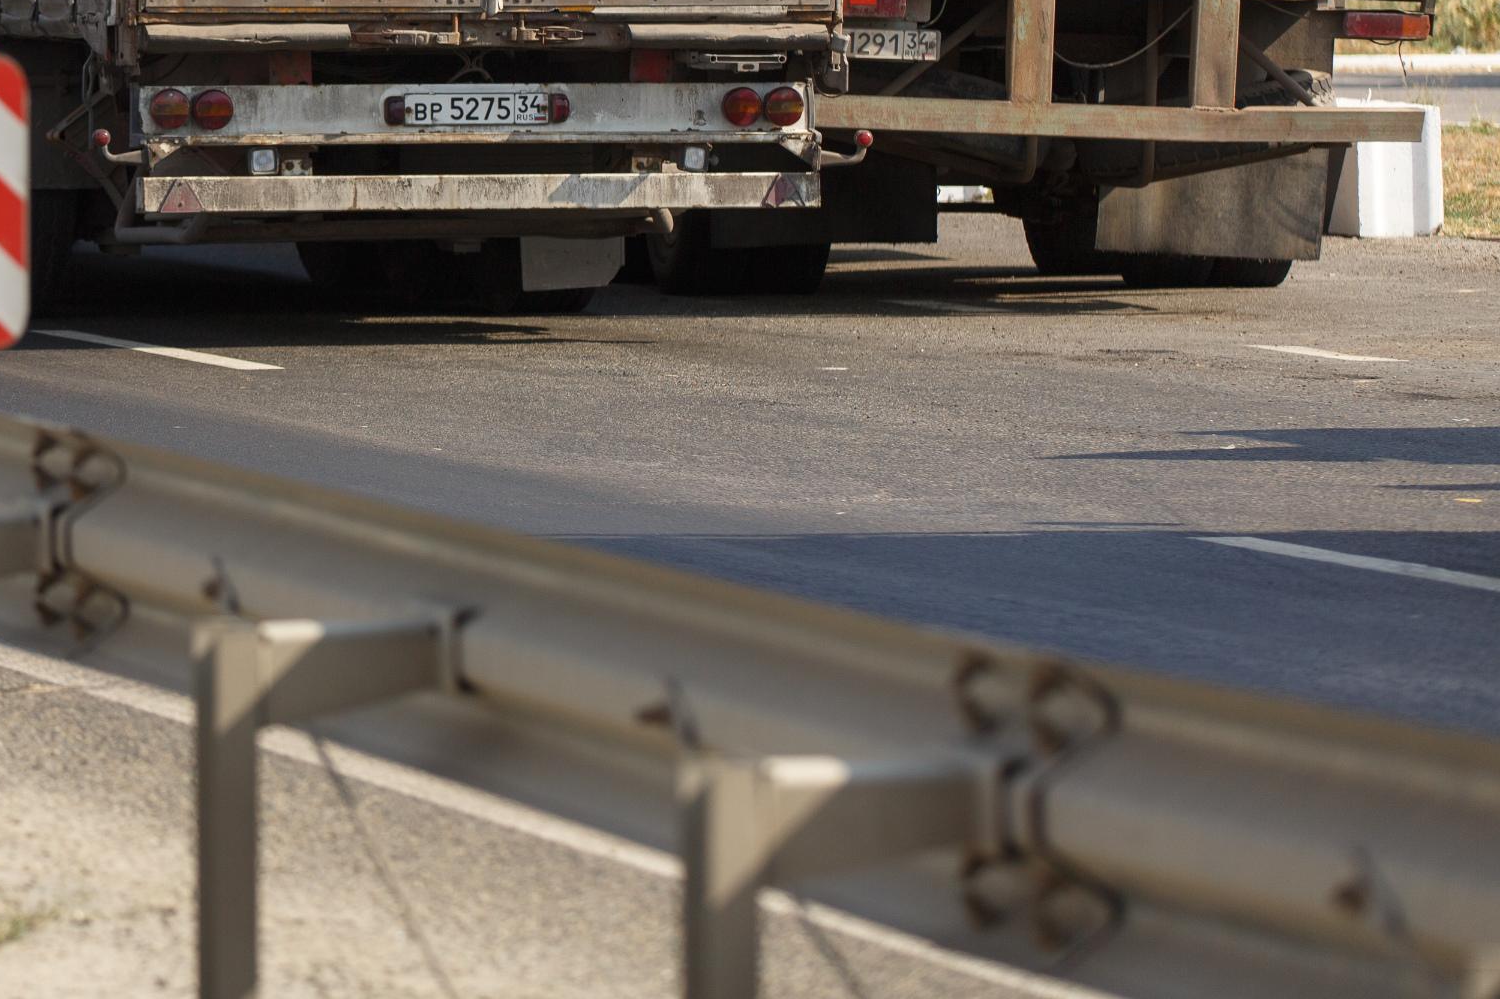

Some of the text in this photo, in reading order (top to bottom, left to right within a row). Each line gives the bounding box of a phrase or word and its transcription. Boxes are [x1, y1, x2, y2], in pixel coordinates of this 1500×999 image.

[450, 97, 511, 121] 5275
[518, 95, 541, 114] 34
[516, 113, 534, 121] RUS
